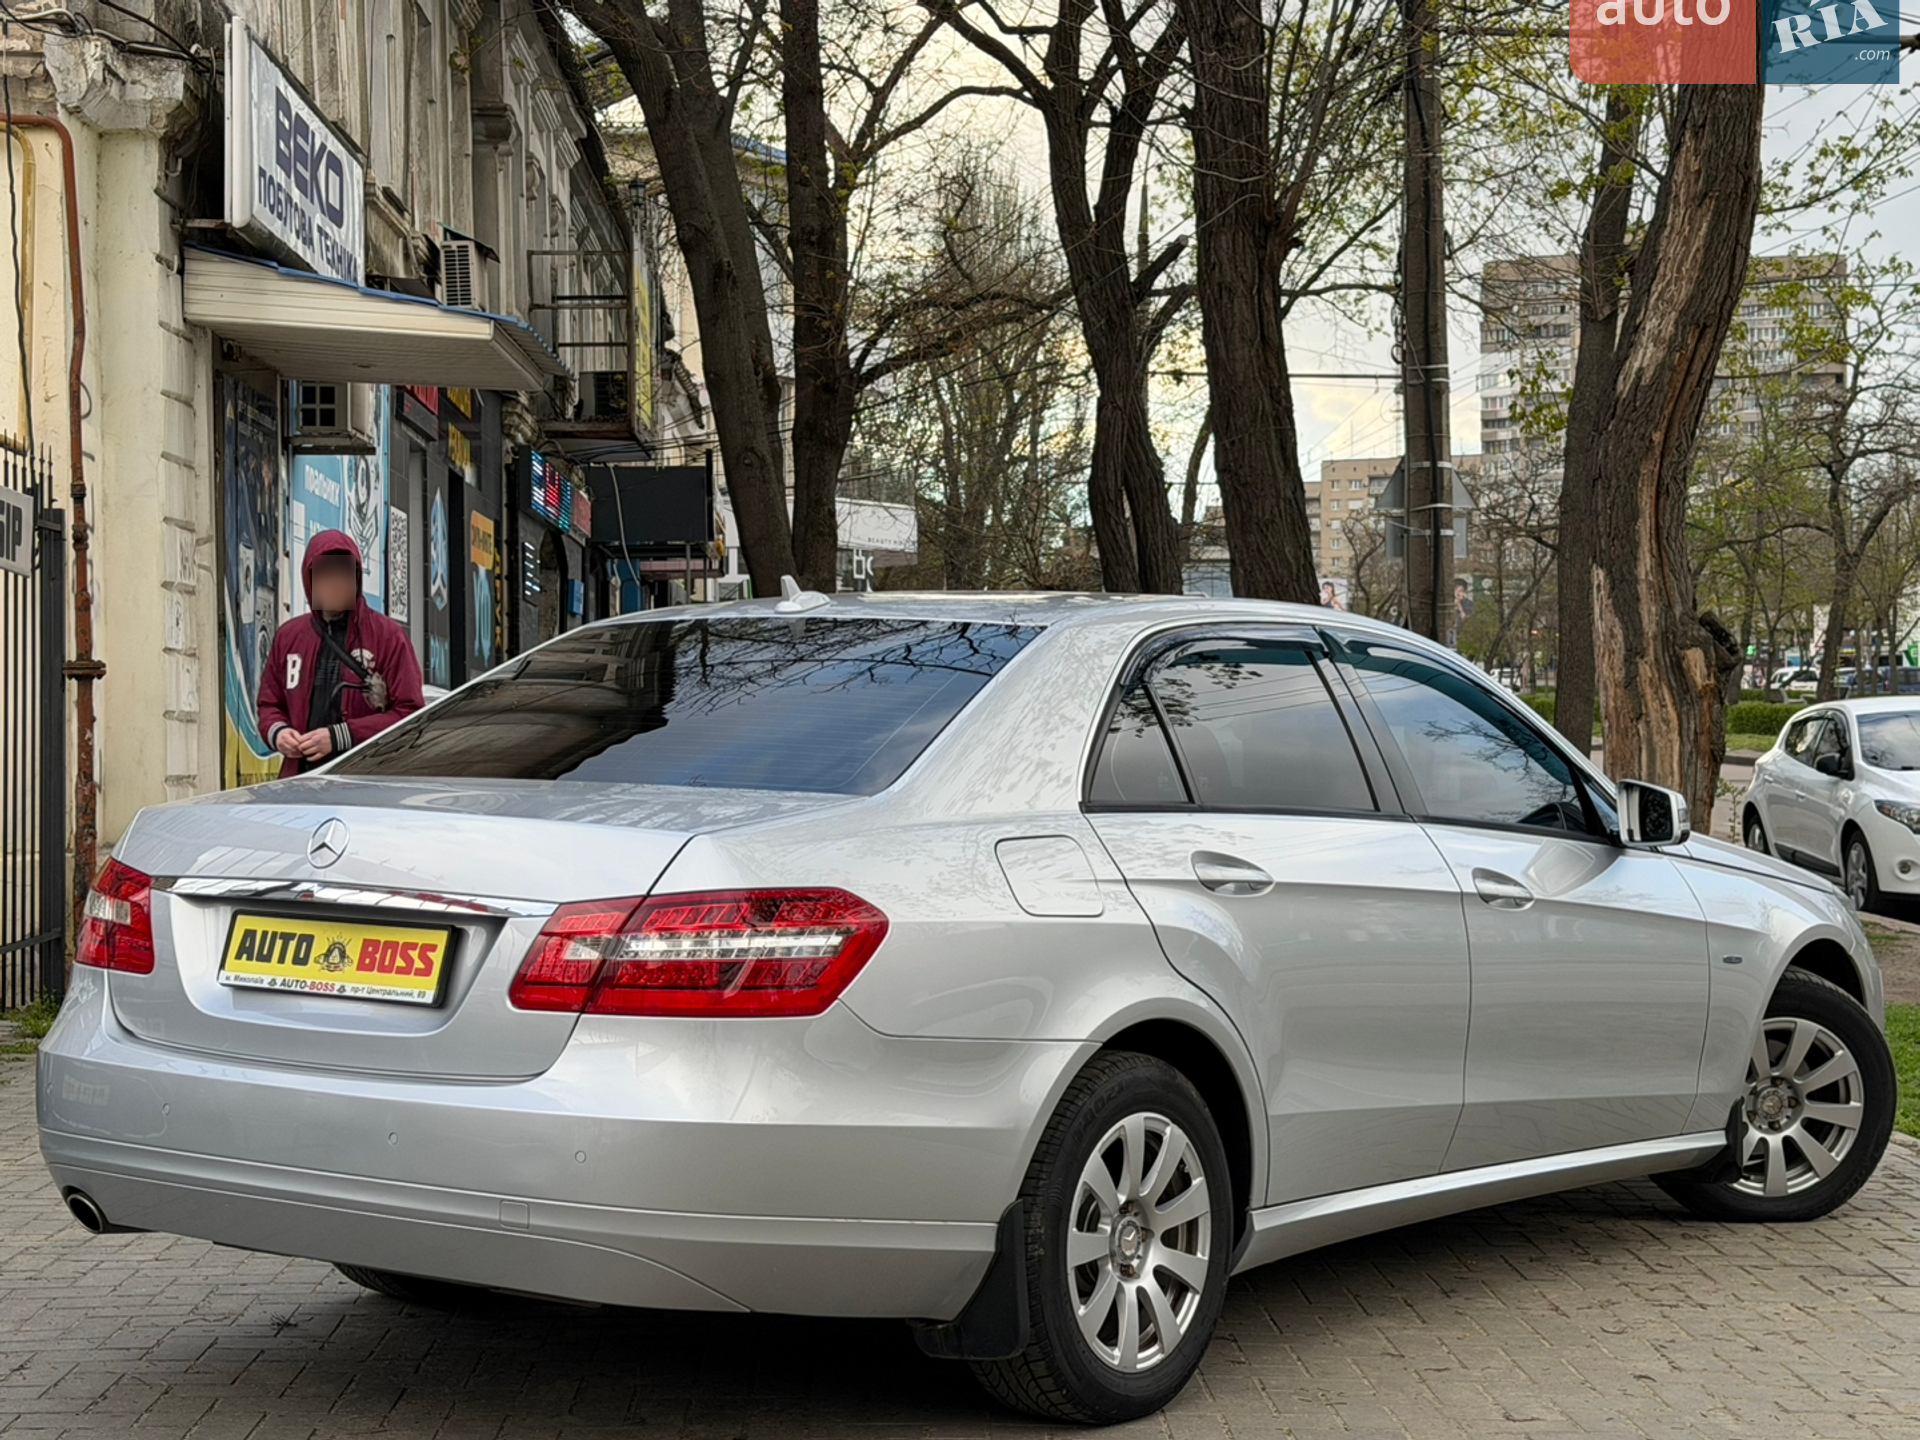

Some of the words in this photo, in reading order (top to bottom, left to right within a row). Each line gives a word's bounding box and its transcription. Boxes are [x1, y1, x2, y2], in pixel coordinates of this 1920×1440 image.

[275, 85, 344, 230] BEKO
[316, 223, 359, 283] ТЕХНІКА
[286, 653, 303, 690] B
[234, 928, 316, 967] AUTO
[355, 938, 439, 978] BOSS
[280, 978, 336, 993] AUTO-BOSS
